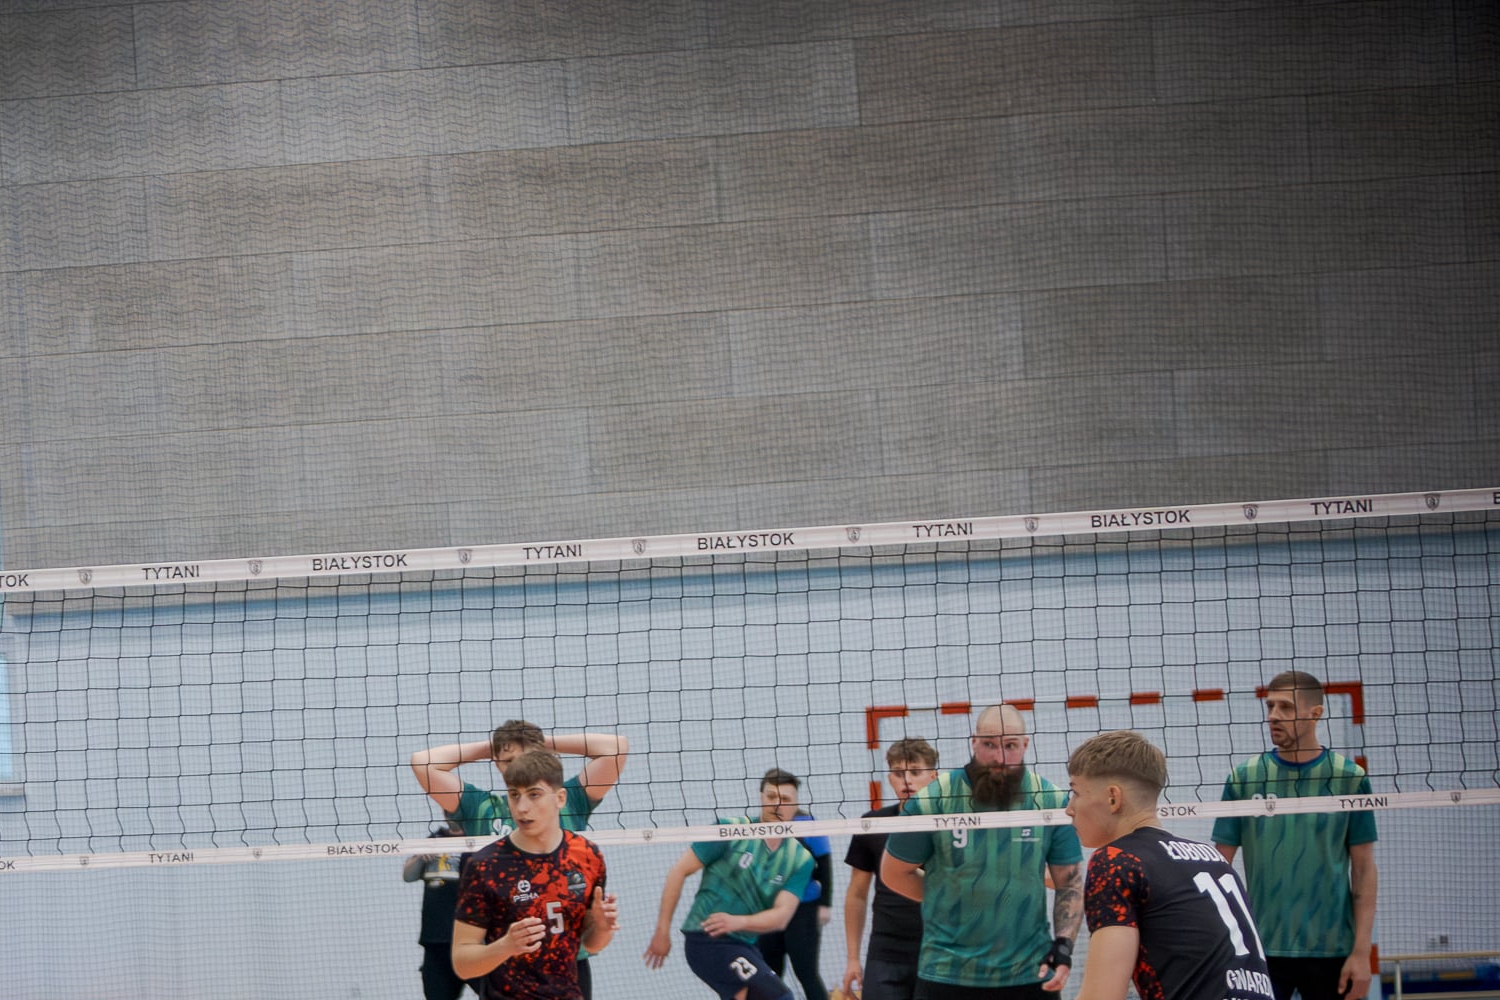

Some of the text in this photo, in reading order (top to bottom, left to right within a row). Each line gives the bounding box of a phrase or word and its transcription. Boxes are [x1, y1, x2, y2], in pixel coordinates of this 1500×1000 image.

[142, 565, 200, 580] TYTANI
[312, 554, 408, 571] BIAŁYSTOK
[523, 544, 582, 559] TYTANI
[697, 532, 795, 550] BIAŁYSTOK
[912, 522, 974, 538] TYTANI
[1090, 510, 1191, 528] BIAŁYSTOK
[1311, 499, 1373, 516] TYTANI
[148, 852, 194, 863] TYTANI
[327, 843, 400, 856] BIAŁYSTOK
[719, 825, 794, 838] BIAŁYSTOK
[933, 816, 981, 828] TYTANI
[1339, 796, 1388, 808] TYTANI
[546, 901, 565, 934] 5
[1193, 871, 1267, 962] 11
[729, 956, 758, 981] 23
